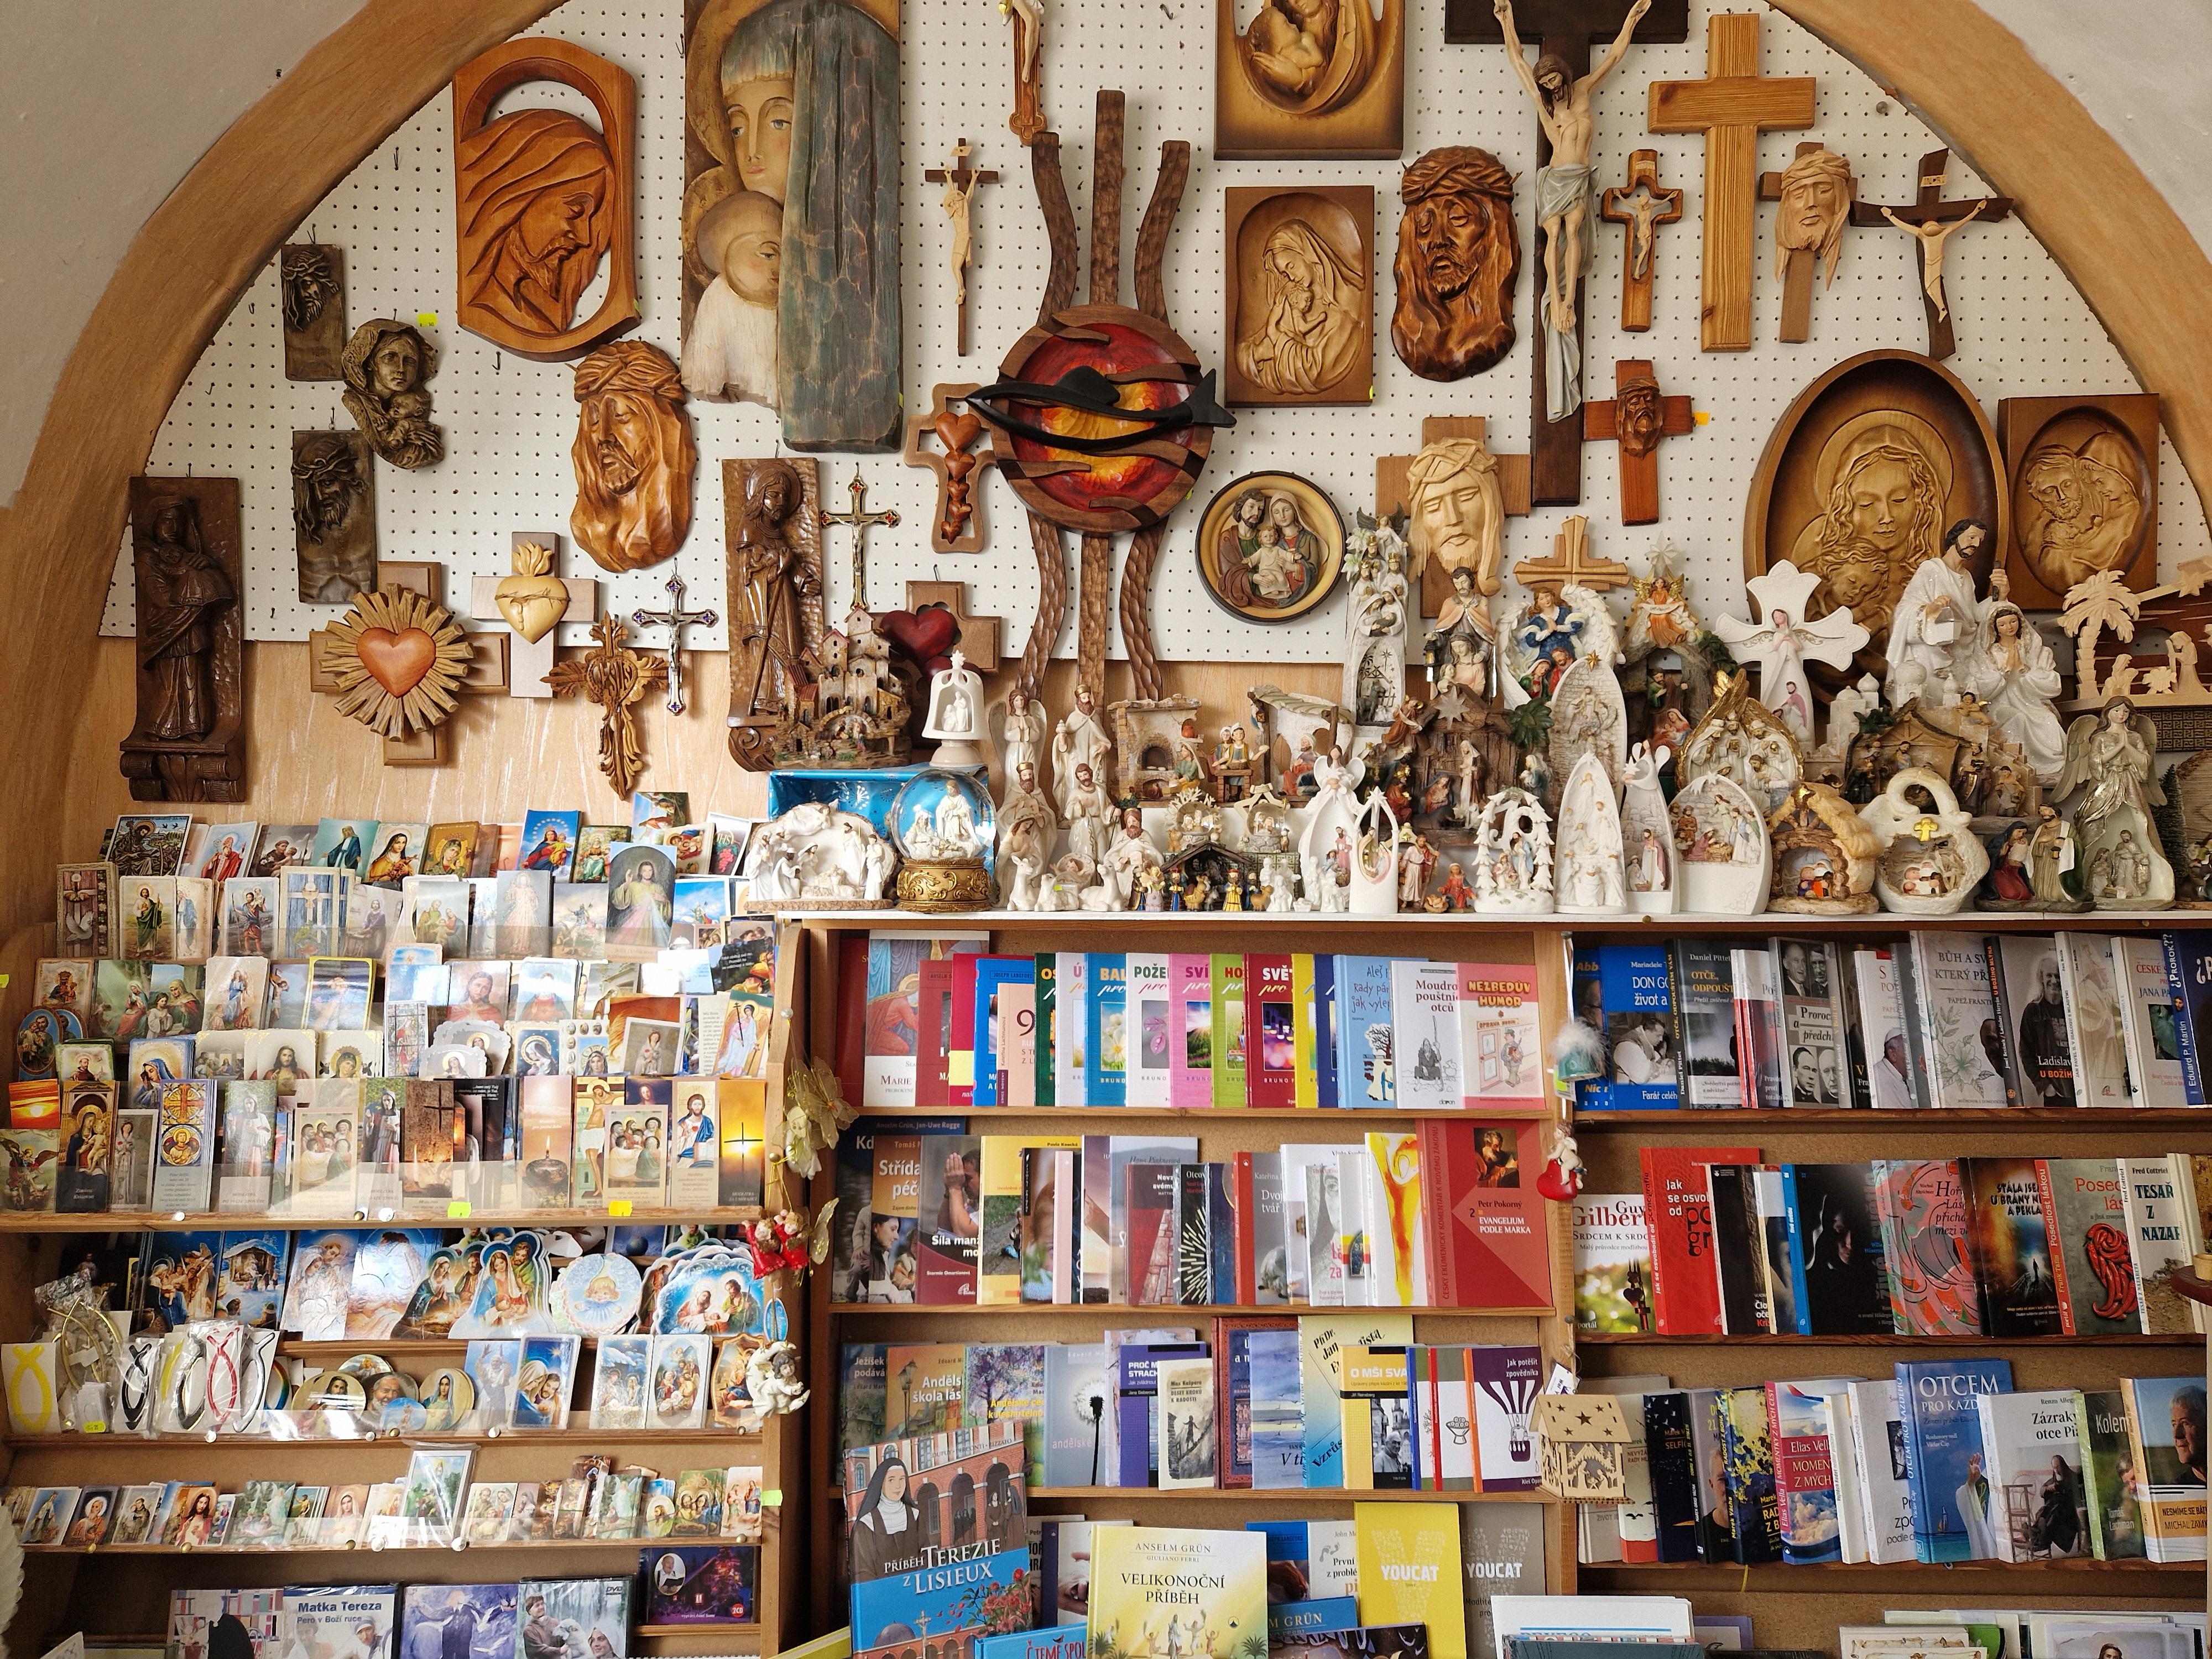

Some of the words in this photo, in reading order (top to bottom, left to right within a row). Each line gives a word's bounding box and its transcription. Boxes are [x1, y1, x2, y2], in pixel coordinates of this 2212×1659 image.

[1938, 950, 1961, 963] BŮH
[1966, 954, 1973, 963] A
[1691, 971, 1719, 982] OTČE,
[1936, 968, 1969, 980] KTERÝ
[1633, 977, 1655, 989] DON
[1258, 984, 1287, 996] pro
[2139, 987, 2159, 998] JANA
[1478, 996, 1522, 1006] HUMOR
[1634, 992, 1659, 1005] život
[1431, 1002, 1454, 1013] otců
[2180, 1021, 2190, 1045] Martin
[2186, 1057, 2197, 1087] Eduard
[1667, 1179, 1682, 1191] Jak
[1996, 1182, 2022, 1194] STÁLA
[2039, 1168, 2050, 1199] láskou
[2135, 1181, 2173, 1199] TESAŘ
[1668, 1194, 1679, 1202] se
[1991, 1195, 1999, 1206] U
[2000, 1193, 2029, 1205] BRÁNY
[1261, 1203, 1280, 1213] tvář
[1494, 1200, 1522, 1210] Pokorný
[1669, 1206, 1682, 1216] od
[1470, 1208, 1475, 1217] 2
[2146, 1205, 2154, 1219] Z
[1480, 1225, 1503, 1234] PODLE
[2045, 1200, 2057, 1247] Posedlost
[932, 1235, 951, 1245] Síla
[1577, 1321, 1597, 1329] portál
[1507, 1359, 1517, 1367] Jak
[1518, 1358, 1538, 1368] potěšit
[1351, 1369, 1359, 1378] O
[1362, 1366, 1383, 1378] MŠI
[1506, 1369, 1538, 1378] zpovědníka
[1919, 1374, 1999, 1397] OTCEM
[913, 1390, 941, 1403] škola
[1922, 1400, 1944, 1412] PRO
[2036, 1427, 2061, 1440] otce
[1053, 1438, 1092, 1449] andělské
[1791, 1440, 1811, 1453] Elias
[1794, 1476, 1802, 1488] Z
[2106, 1507, 2124, 1520] Tomáš
[2162, 1506, 2188, 1516] NESMÍME
[2188, 1506, 2196, 1515] SE
[2109, 1519, 2134, 1531] Lachman
[2164, 1519, 2190, 1530] MICHAL
[1135, 1543, 1178, 1552] ANSELM
[1181, 1542, 1211, 1553] GRÜN
[884, 1556, 924, 1573] PŘÍBĚH
[921, 1538, 1001, 1569] TEREZIE
[1333, 1557, 1355, 1566] První
[1381, 1564, 1439, 1582] YOUCAT
[1465, 1562, 1522, 1579] YOUCAT
[914, 1561, 994, 1595] LISIEUX
[1121, 1573, 1225, 1589] VELIKONOČNÍ
[1146, 1589, 1199, 1604] PŘÍBĚH
[298, 1602, 337, 1613] Matka
[341, 1601, 382, 1611] Tereza
[296, 1616, 315, 1625] Pero
[325, 1614, 342, 1624] Boží
[1284, 1612, 1322, 1627] GRÜN
